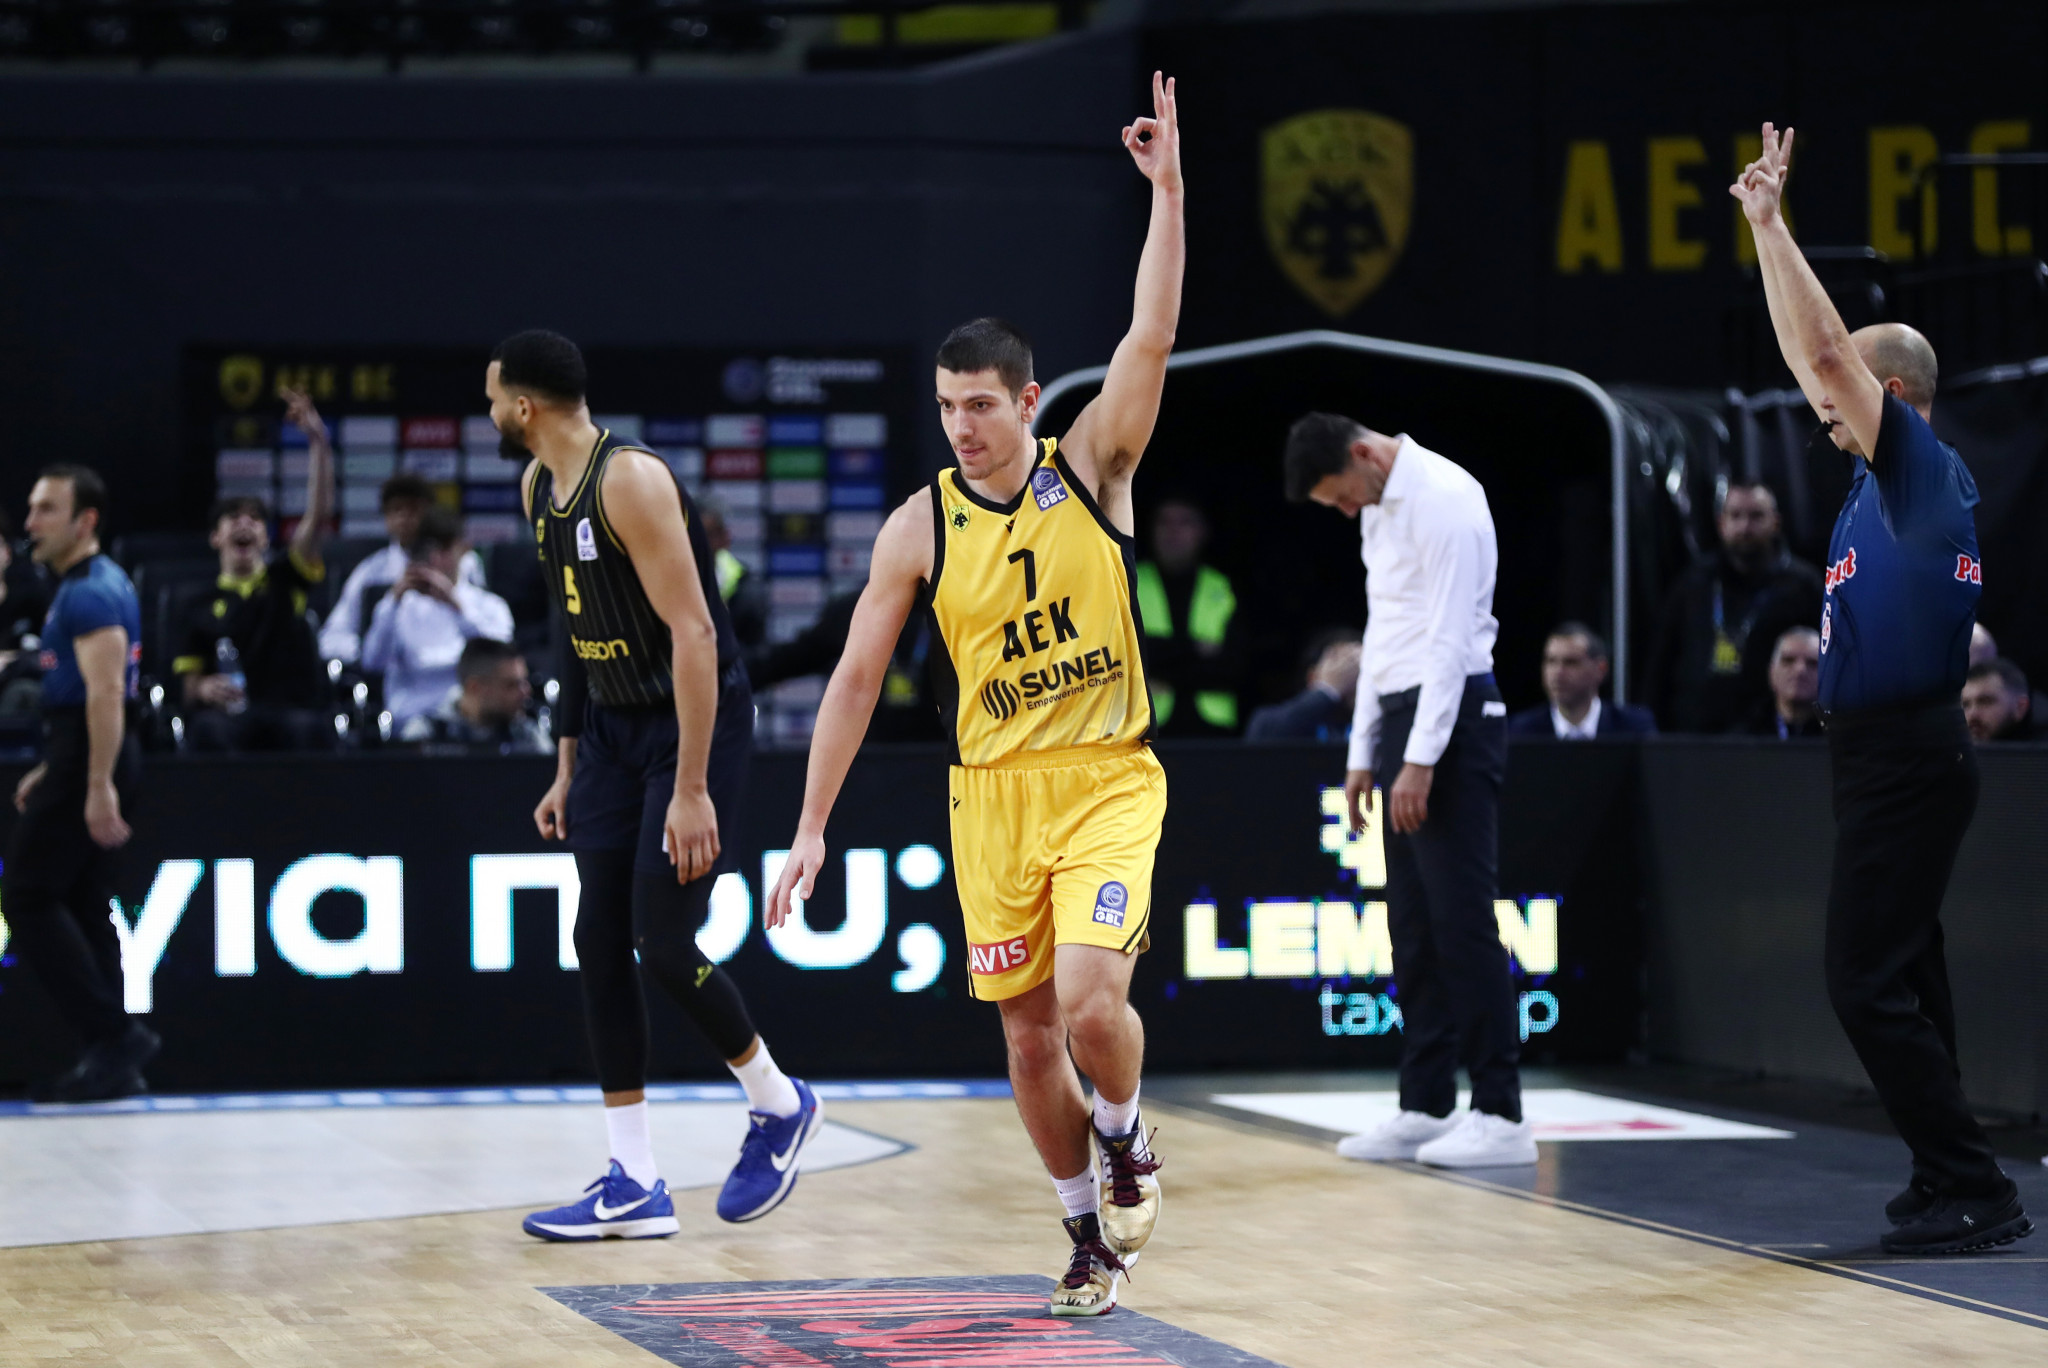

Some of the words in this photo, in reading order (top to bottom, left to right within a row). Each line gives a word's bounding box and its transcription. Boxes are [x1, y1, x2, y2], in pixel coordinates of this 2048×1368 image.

[1866, 119, 2034, 264] BC
[1040, 490, 1066, 508] GBL
[563, 565, 582, 615] 5
[1007, 548, 1037, 602] 7
[1955, 553, 1982, 586] Pa
[1002, 596, 1079, 663] AEK
[1020, 646, 1122, 698] SUNEL
[1026, 683, 1085, 711] Empowering
[1088, 670, 1124, 689] Change
[1095, 911, 1121, 927] GBL
[1183, 899, 1559, 980] LEMN
[971, 939, 1028, 973] AVIS
[799, 1318, 1184, 1368] SUN
